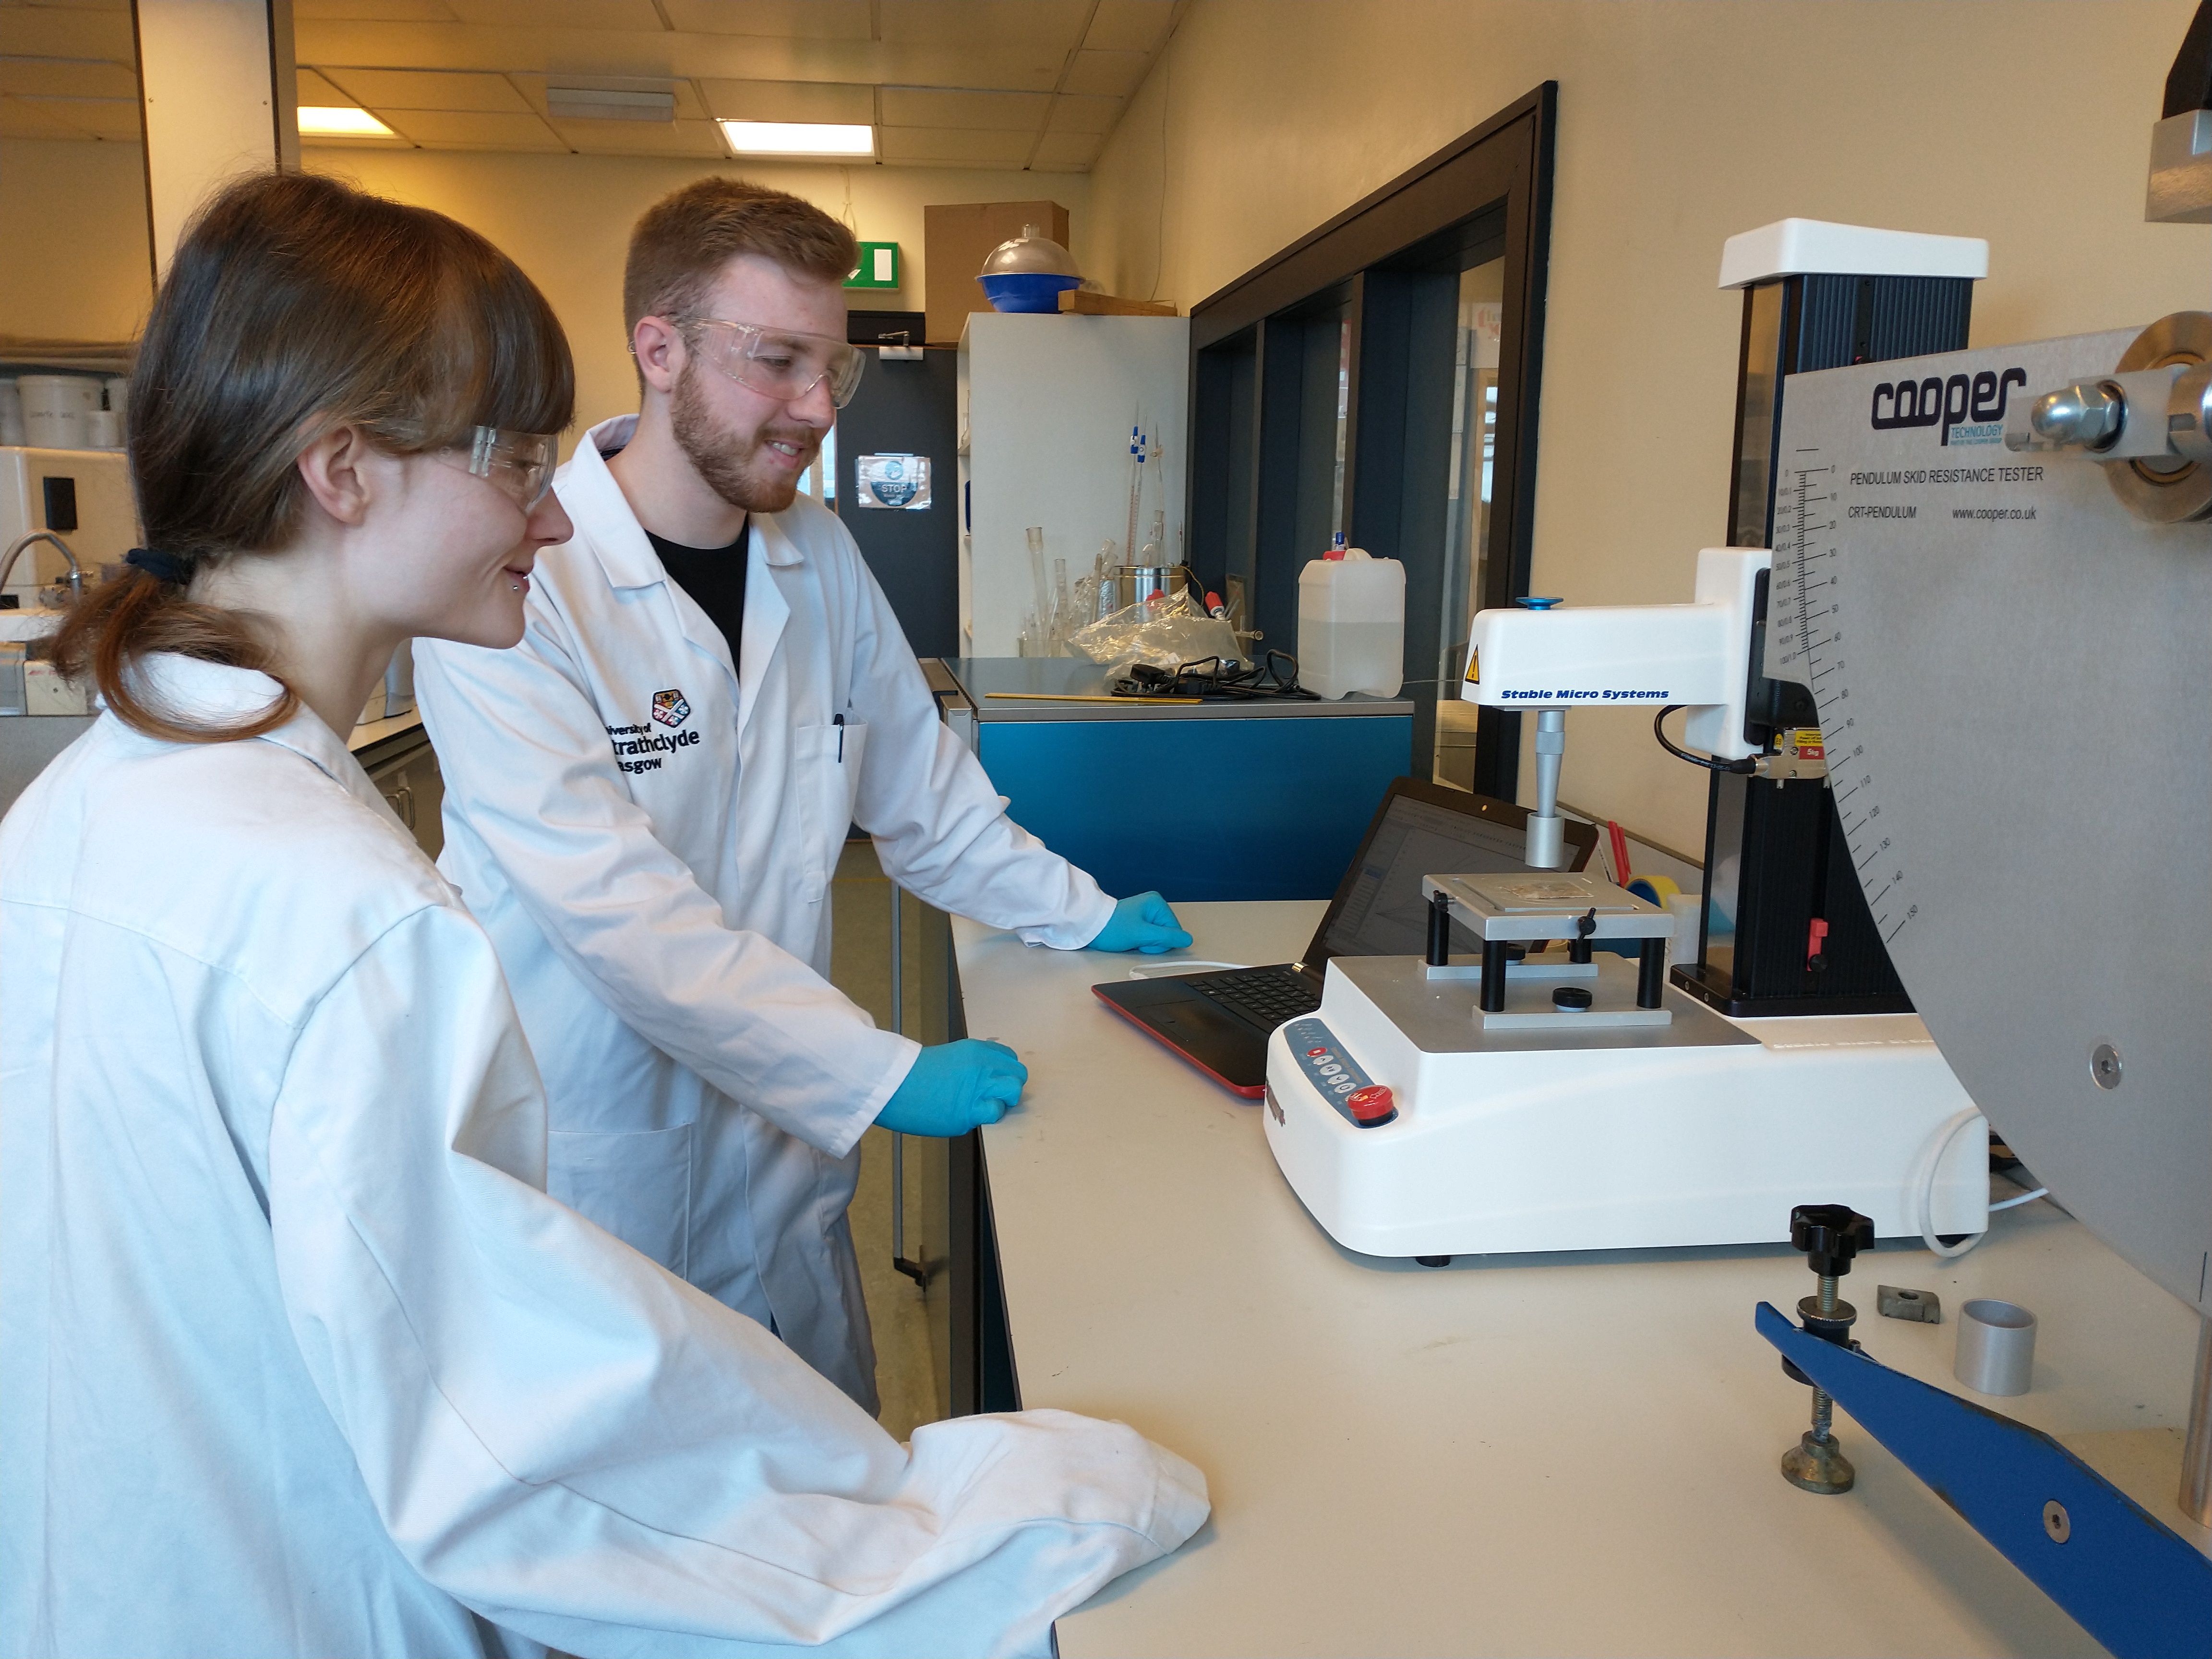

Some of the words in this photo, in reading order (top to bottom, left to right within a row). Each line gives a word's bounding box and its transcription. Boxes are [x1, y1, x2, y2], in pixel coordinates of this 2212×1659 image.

[1872, 367, 2026, 446] cooper
[1950, 424, 2003, 438] TECHNOLOGY
[1850, 470, 1901, 485] PENDULUM
[1904, 469, 1926, 484] SKID
[1930, 468, 1996, 483] RESISTANCE
[1998, 466, 2044, 481] TESTER
[881, 484, 907, 493] STOP
[1848, 506, 1916, 519] CRT-PENDULUM
[1952, 506, 2036, 522] www.cooper.co.uk
[1837, 660, 1845, 670] 70
[1501, 690, 1552, 699] Stable
[1555, 690, 1599, 698] Micro
[1601, 690, 1670, 700] Systems
[605, 724, 643, 735] iversity
[612, 729, 700, 755] trathclyde
[1853, 745, 1863, 757] 100
[618, 757, 662, 774] asgow
[1860, 774, 1871, 788] 110
[1869, 805, 1880, 819] 120
[1879, 837, 1890, 851] 130
[1892, 870, 1903, 884] 140
[1907, 904, 1918, 920] 150
